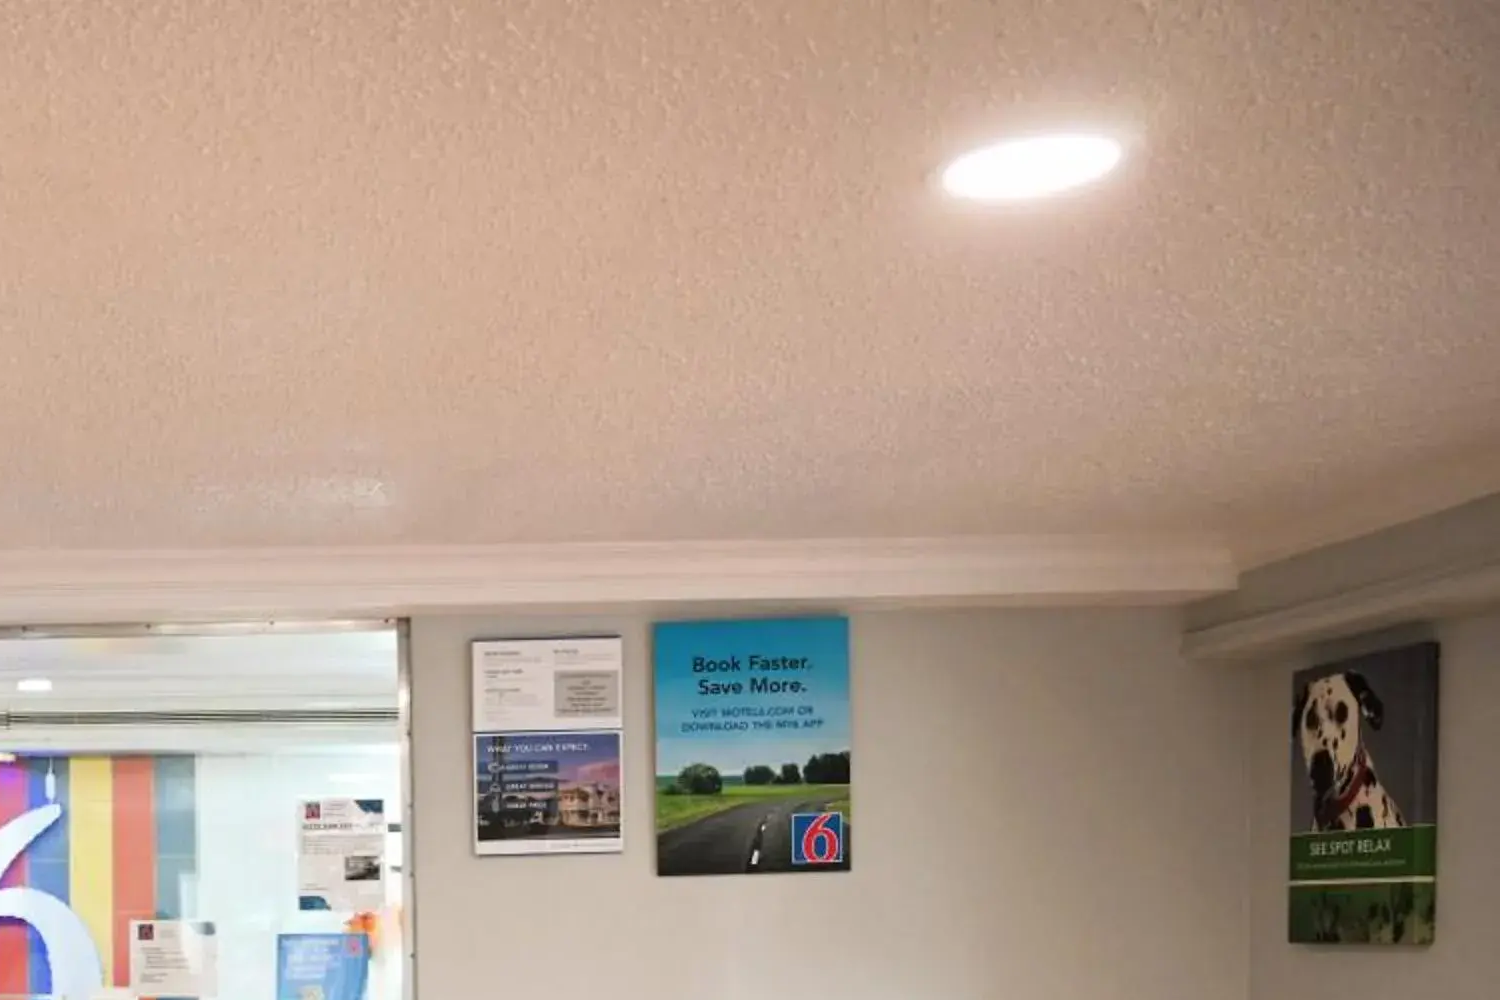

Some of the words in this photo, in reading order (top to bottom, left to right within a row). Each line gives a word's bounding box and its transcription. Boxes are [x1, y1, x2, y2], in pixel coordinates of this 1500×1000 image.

[692, 655, 741, 673] Book
[748, 655, 813, 671] Faster.
[697, 679, 743, 695] Save
[749, 677, 808, 694] More.
[801, 812, 841, 863] 6
